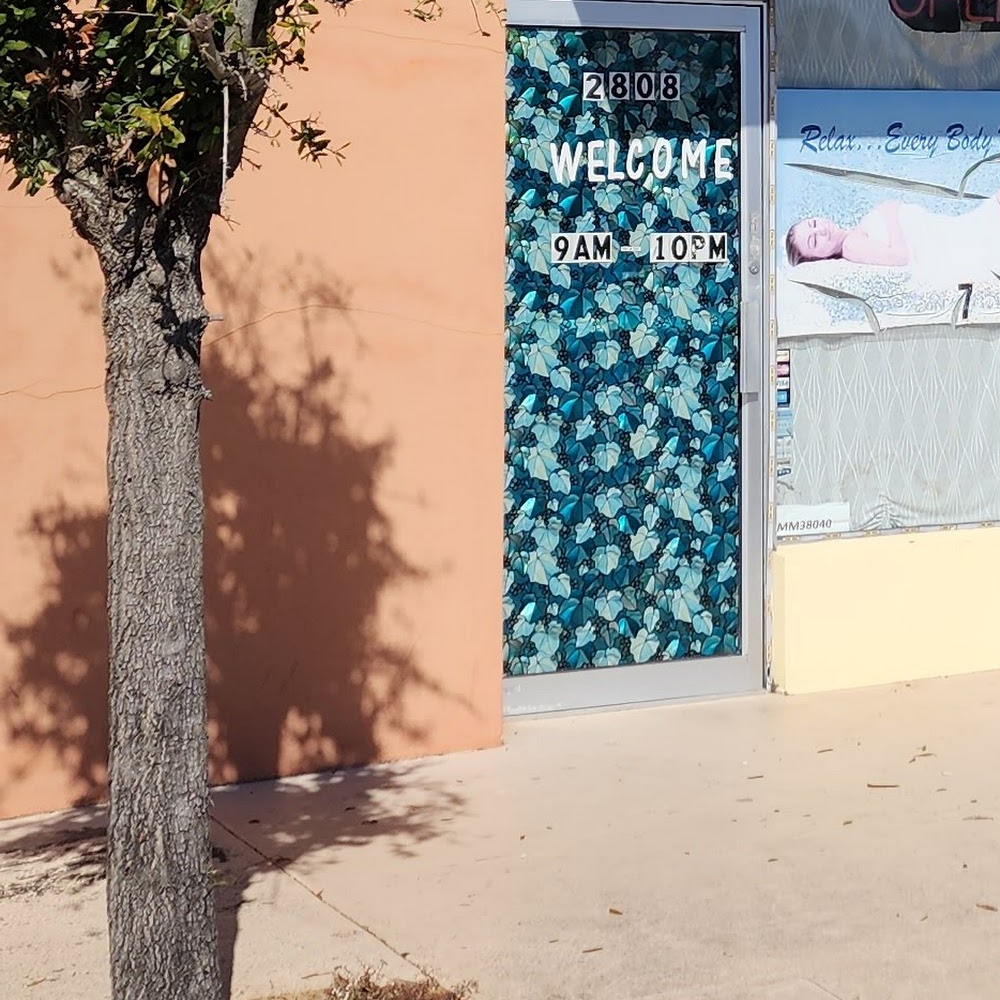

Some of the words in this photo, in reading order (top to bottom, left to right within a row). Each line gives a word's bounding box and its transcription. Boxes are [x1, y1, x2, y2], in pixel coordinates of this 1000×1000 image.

[585, 74, 680, 100] 2808
[946, 123, 992, 158] Body
[550, 137, 733, 182] WELCOME
[553, 234, 612, 262] 9AM
[655, 234, 727, 261] 10PM
[776, 518, 833, 532] MM38040
